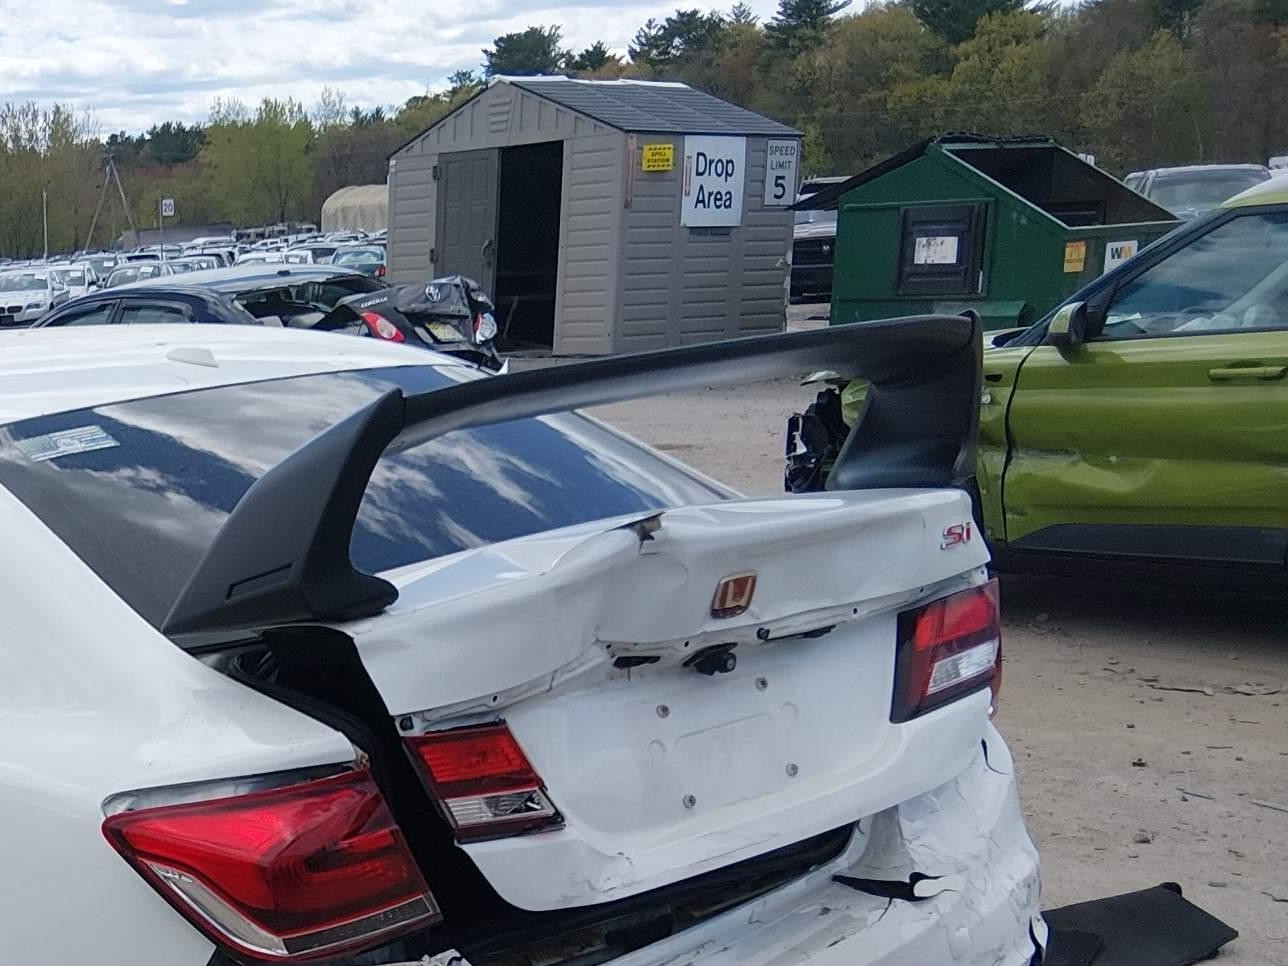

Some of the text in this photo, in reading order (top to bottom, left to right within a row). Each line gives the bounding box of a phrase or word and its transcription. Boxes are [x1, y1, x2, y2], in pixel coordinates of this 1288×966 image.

[769, 145, 796, 156] SPEED
[695, 152, 735, 183] Drop
[770, 160, 793, 171] LIMIT
[694, 184, 733, 210] Area
[773, 175, 786, 200] 5
